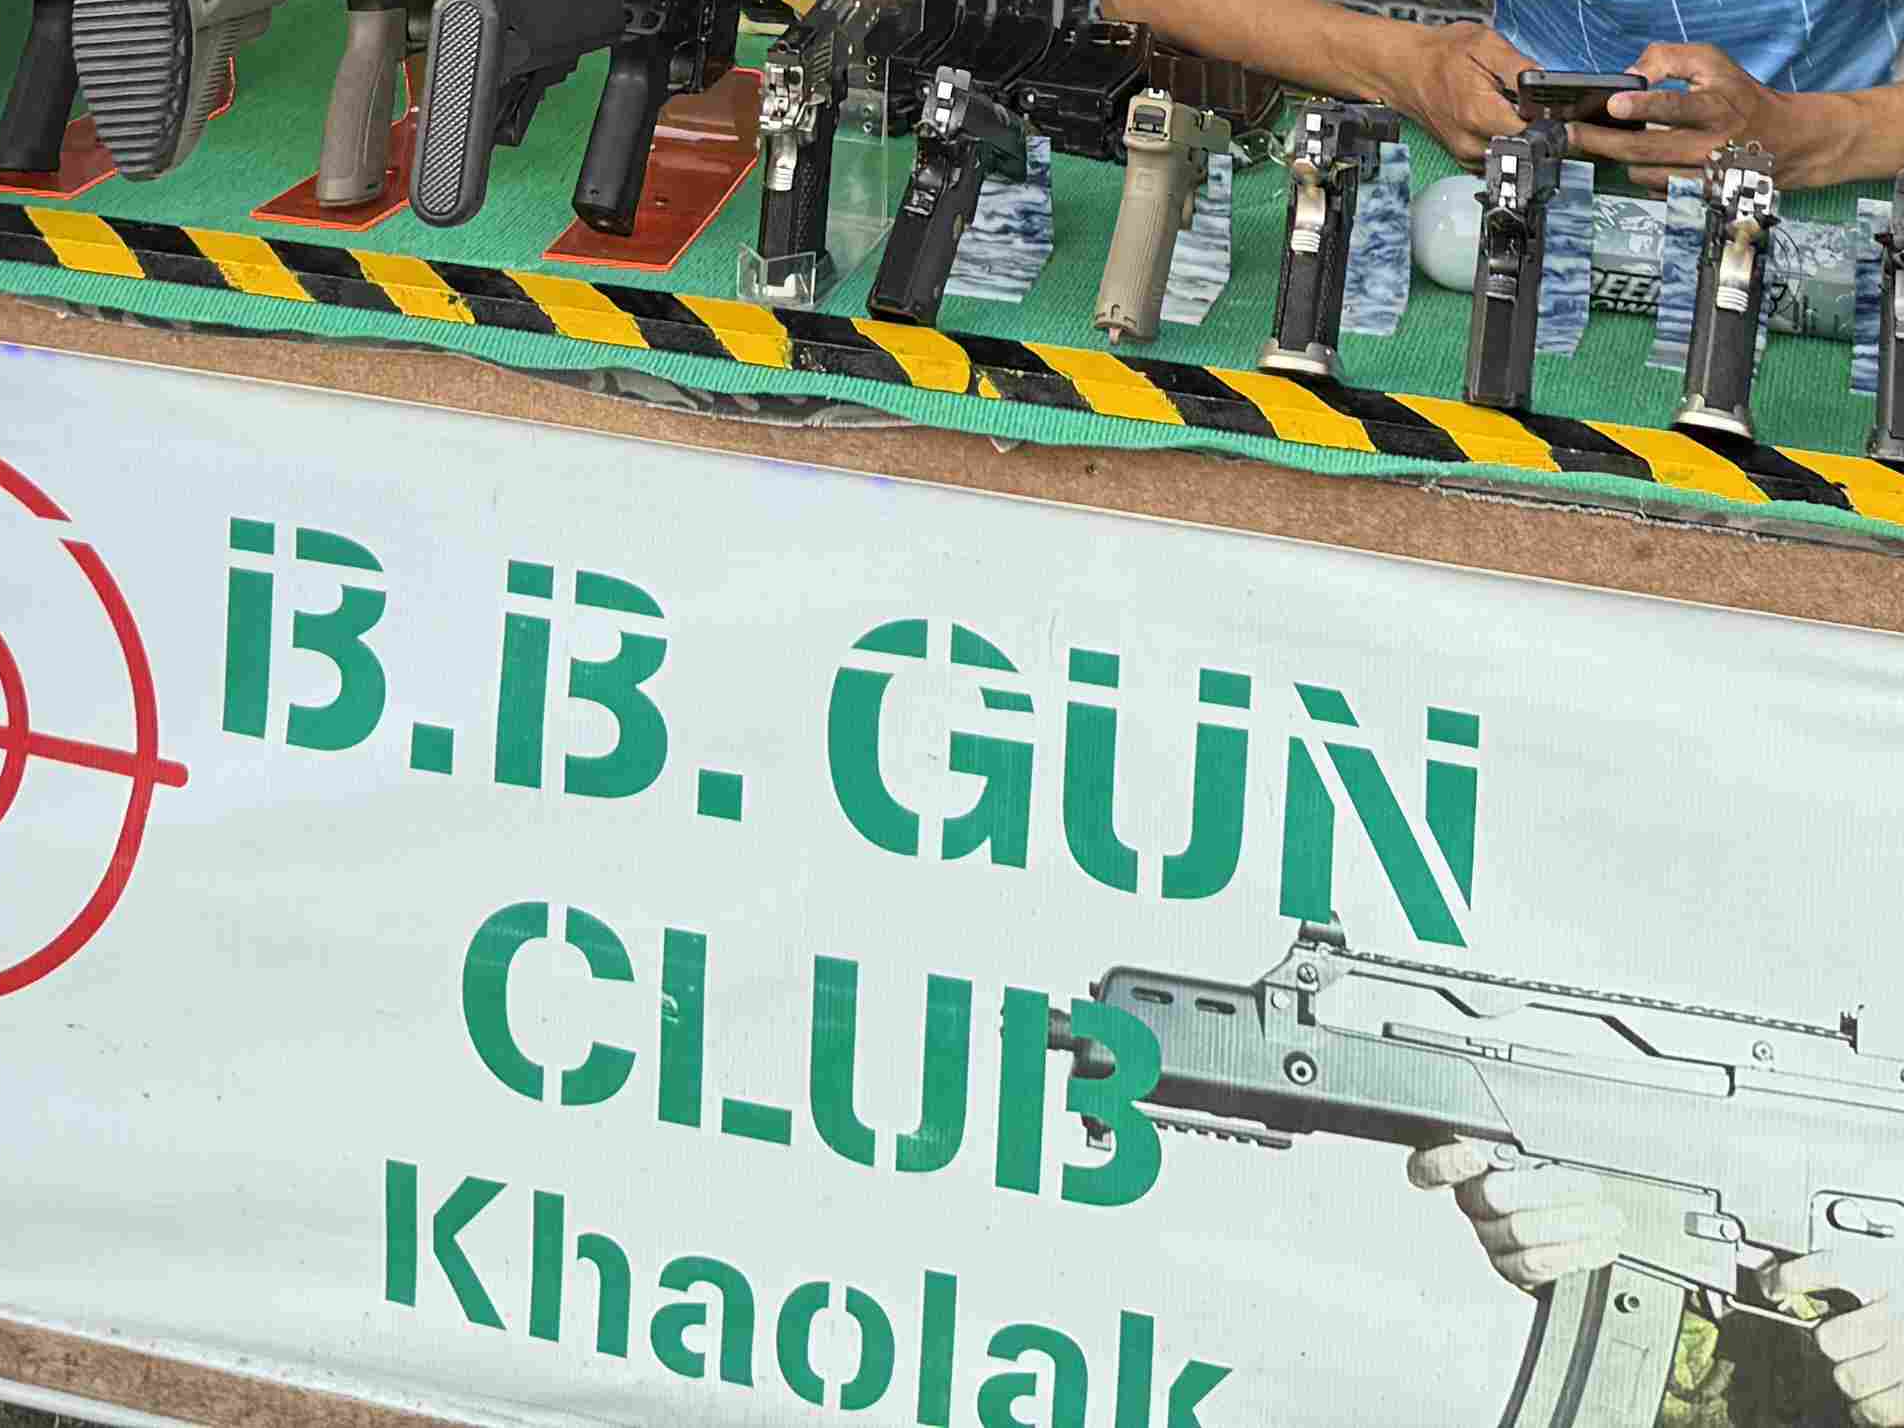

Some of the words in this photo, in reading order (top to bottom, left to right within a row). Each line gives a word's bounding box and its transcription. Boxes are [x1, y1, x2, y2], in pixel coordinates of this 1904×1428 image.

[222, 517, 743, 824] B.B.
[826, 617, 1481, 948] GUN
[461, 900, 1164, 1208] CLUB
[383, 1158, 1233, 1428] Khaolak
